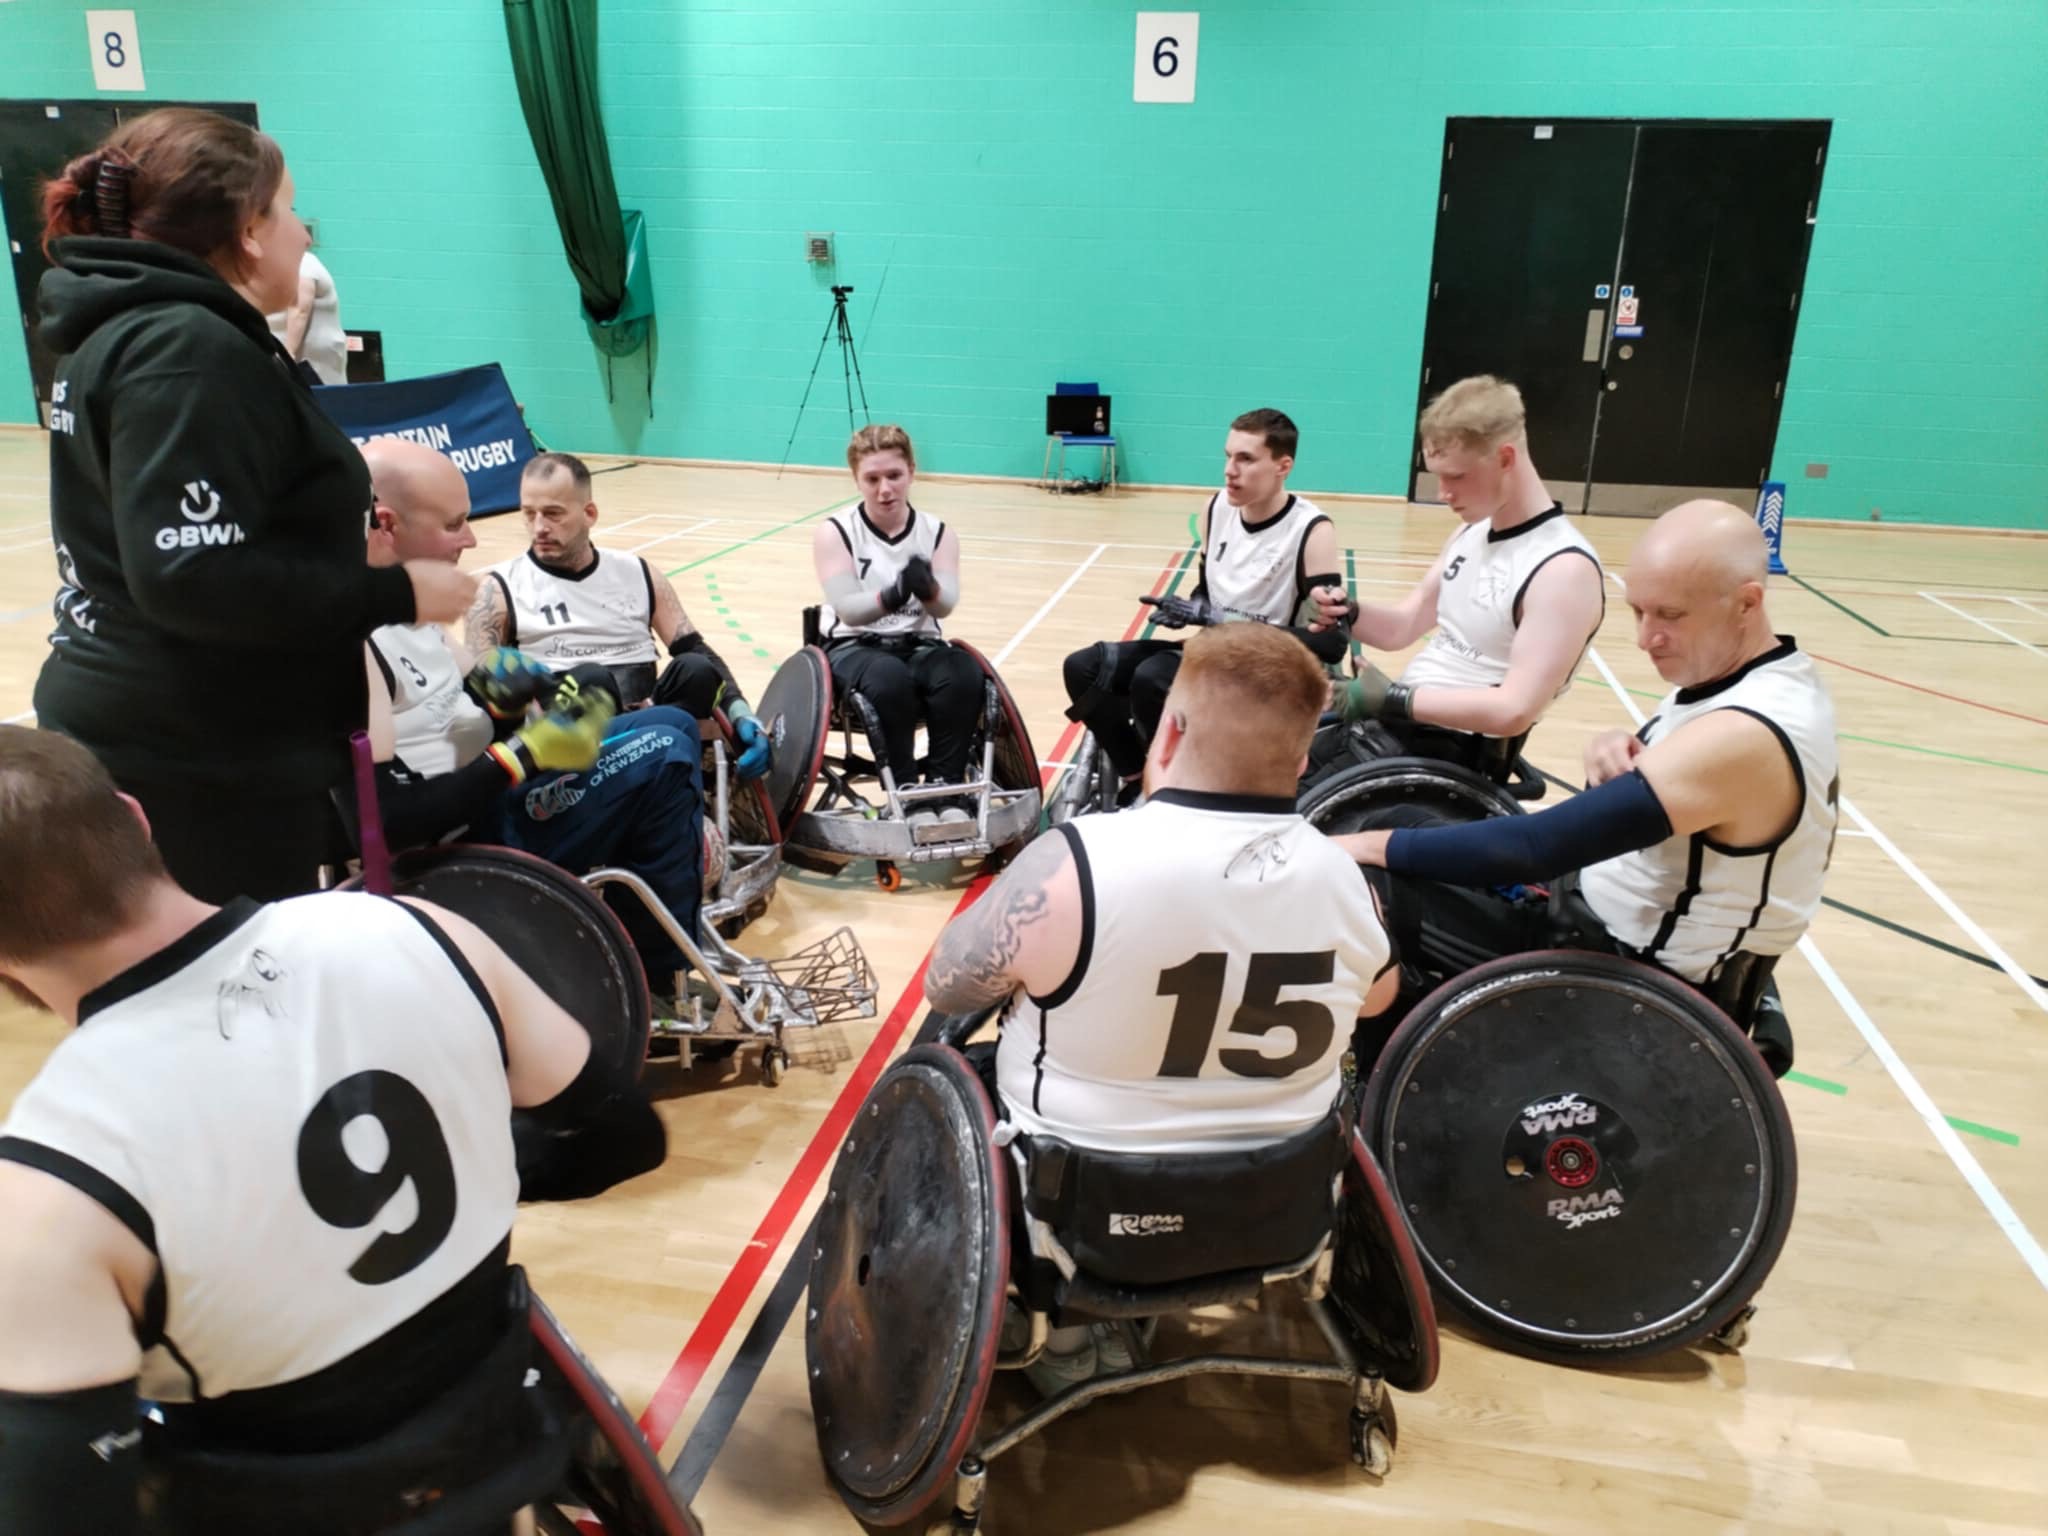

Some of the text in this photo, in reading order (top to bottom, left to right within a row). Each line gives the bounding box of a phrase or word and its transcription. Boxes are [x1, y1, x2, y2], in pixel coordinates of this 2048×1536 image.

[104, 31, 125, 68] 8
[1152, 36, 1179, 77] 6
[450, 439, 516, 473] RUGBY
[1215, 541, 1228, 562] 1
[858, 557, 872, 580] 7
[1443, 555, 1467, 581] 5
[540, 602, 571, 625] 11
[400, 656, 428, 688] 3
[589, 736, 674, 787] OF NEW ZEALAND
[596, 731, 658, 770] CANTERBURY
[1156, 949, 1336, 1079] 15
[1520, 1106, 1597, 1136] RMA
[1523, 1093, 1588, 1118] Sport
[297, 1069, 457, 1285] 9
[1547, 1188, 1624, 1216] RMA
[1556, 1205, 1622, 1230] Sport
